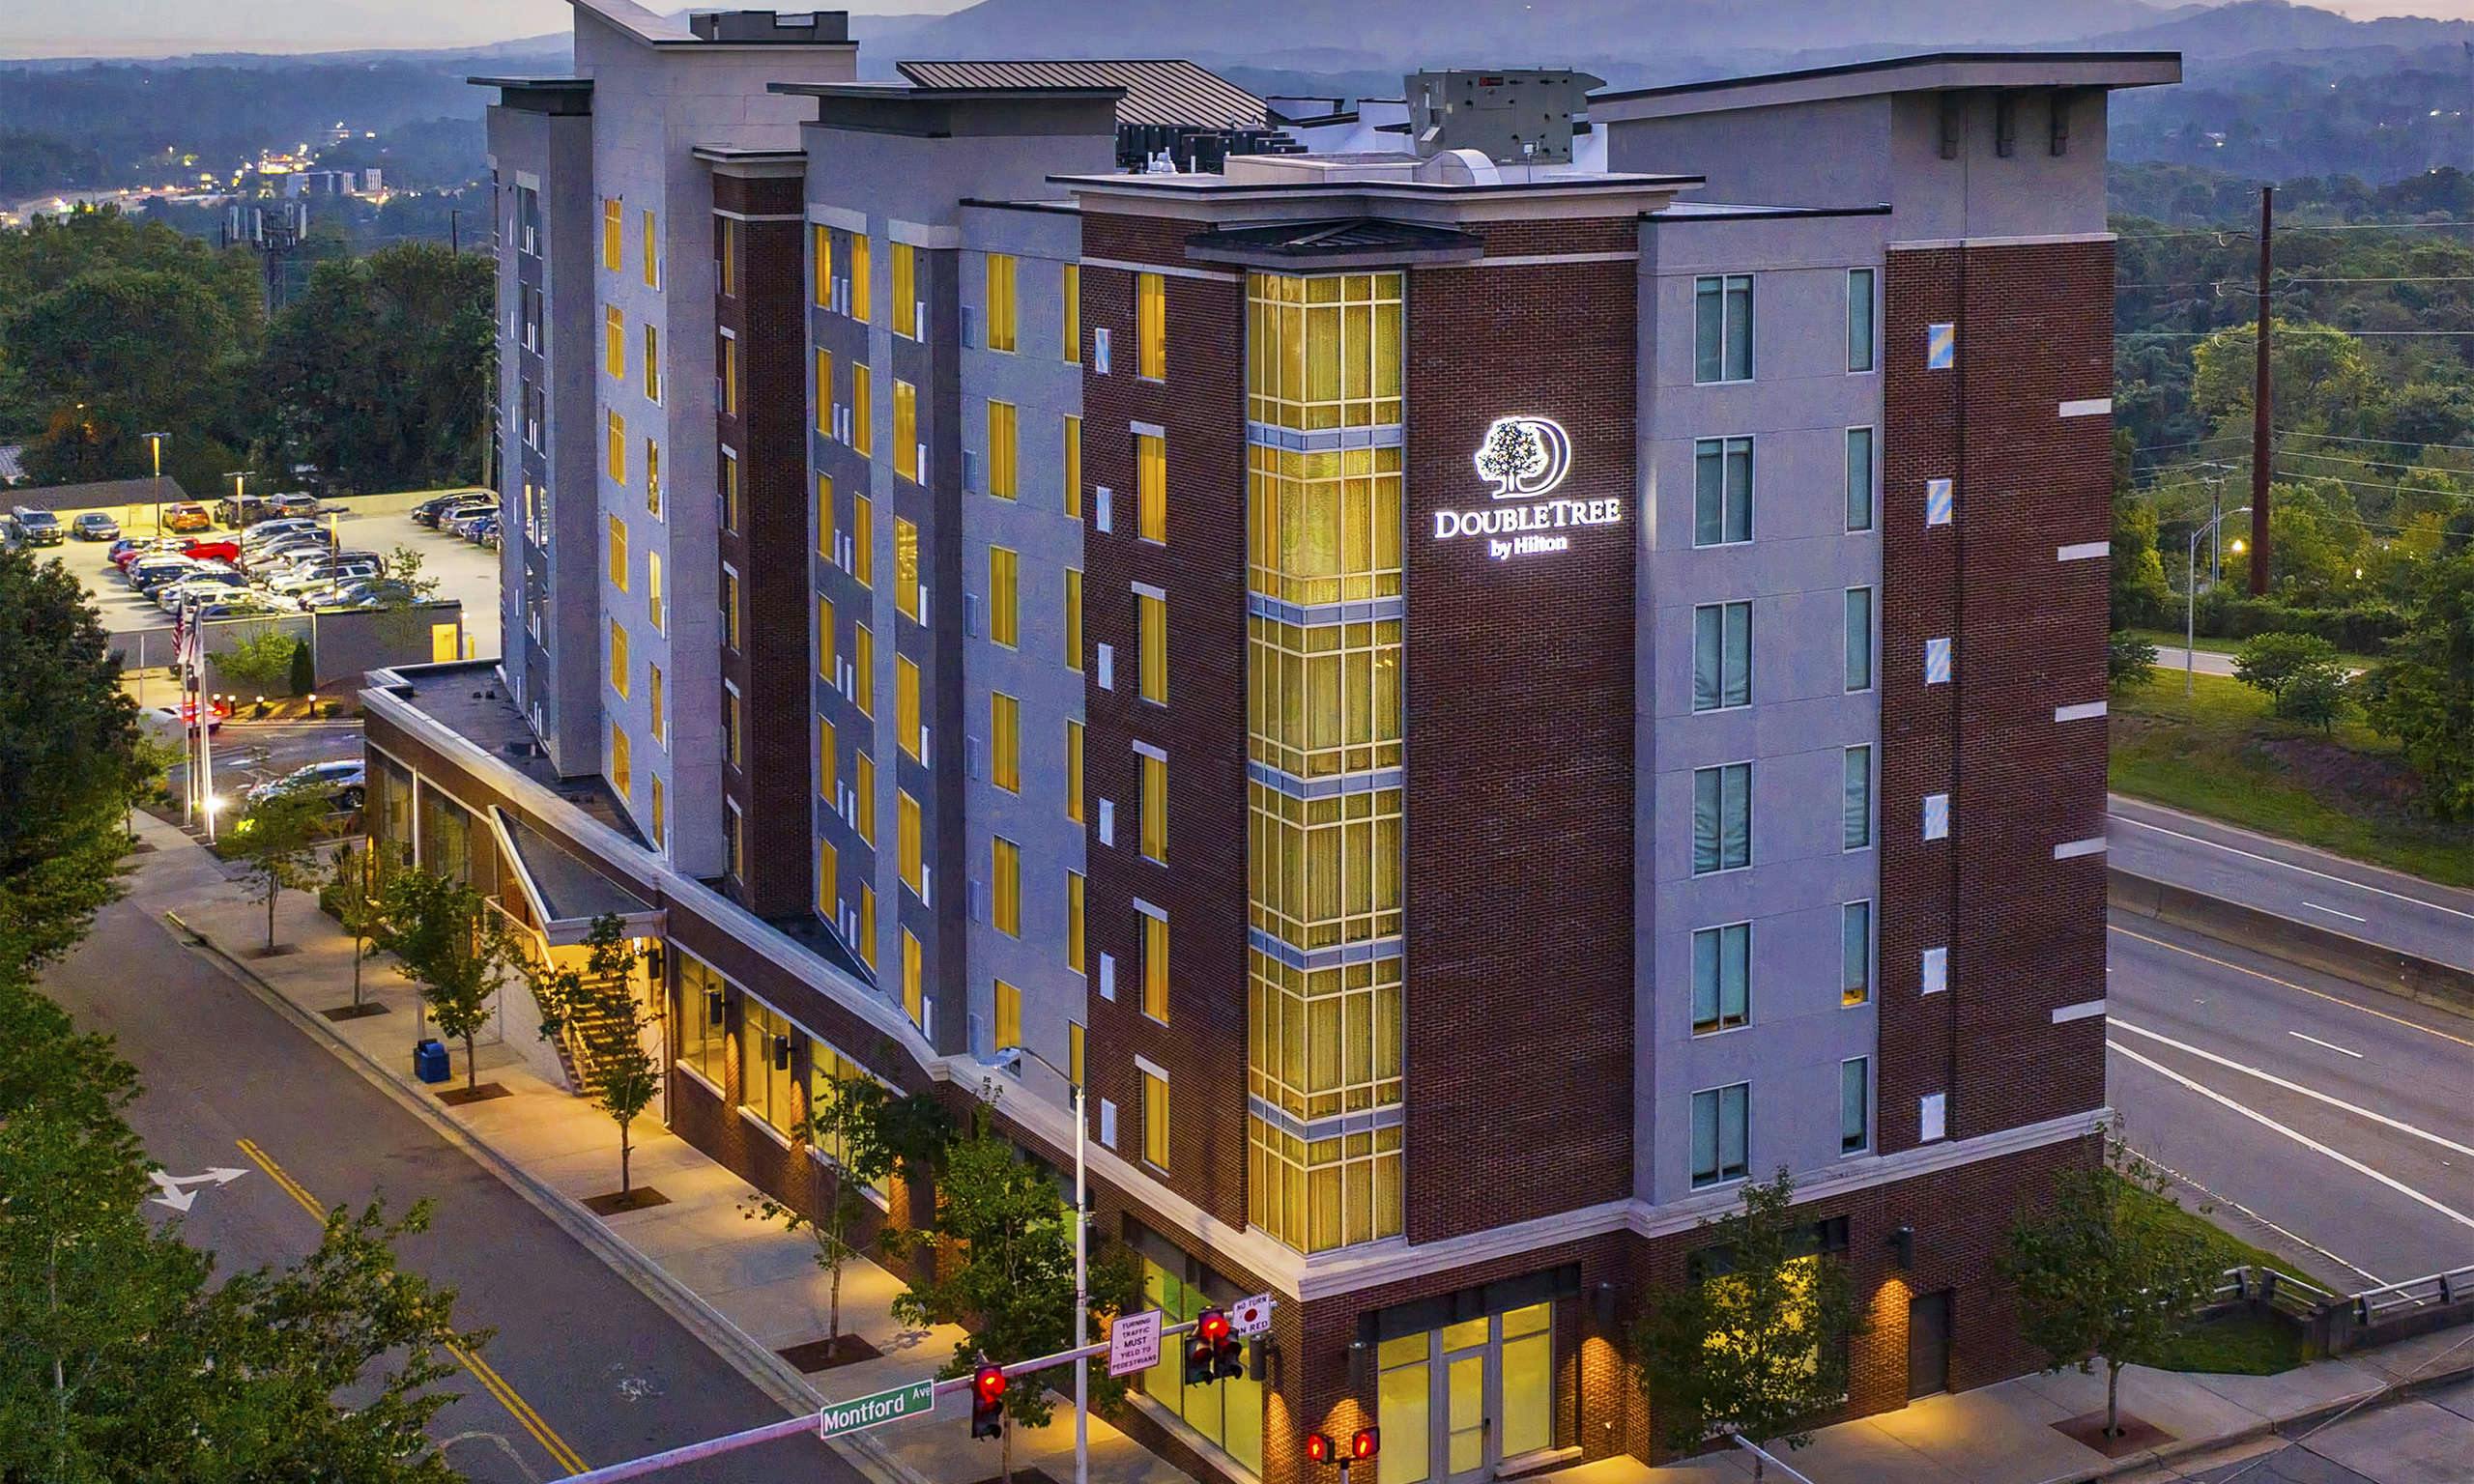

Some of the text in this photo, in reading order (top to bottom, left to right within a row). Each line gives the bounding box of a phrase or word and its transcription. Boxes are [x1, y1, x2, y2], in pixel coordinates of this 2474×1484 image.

[1490, 534, 1568, 560] by Hilton
[1237, 1297, 1267, 1311] NO TURN
[1122, 1318, 1151, 1329] TURNING
[1250, 1320, 1268, 1332] RED
[1122, 1327, 1151, 1339] TRAFFIC
[1124, 1336, 1147, 1348] MUST
[1121, 1349, 1140, 1359] YIELD
[1112, 1355, 1157, 1370] PEDESTRIANS
[823, 1385, 932, 1432] Montford Ave
